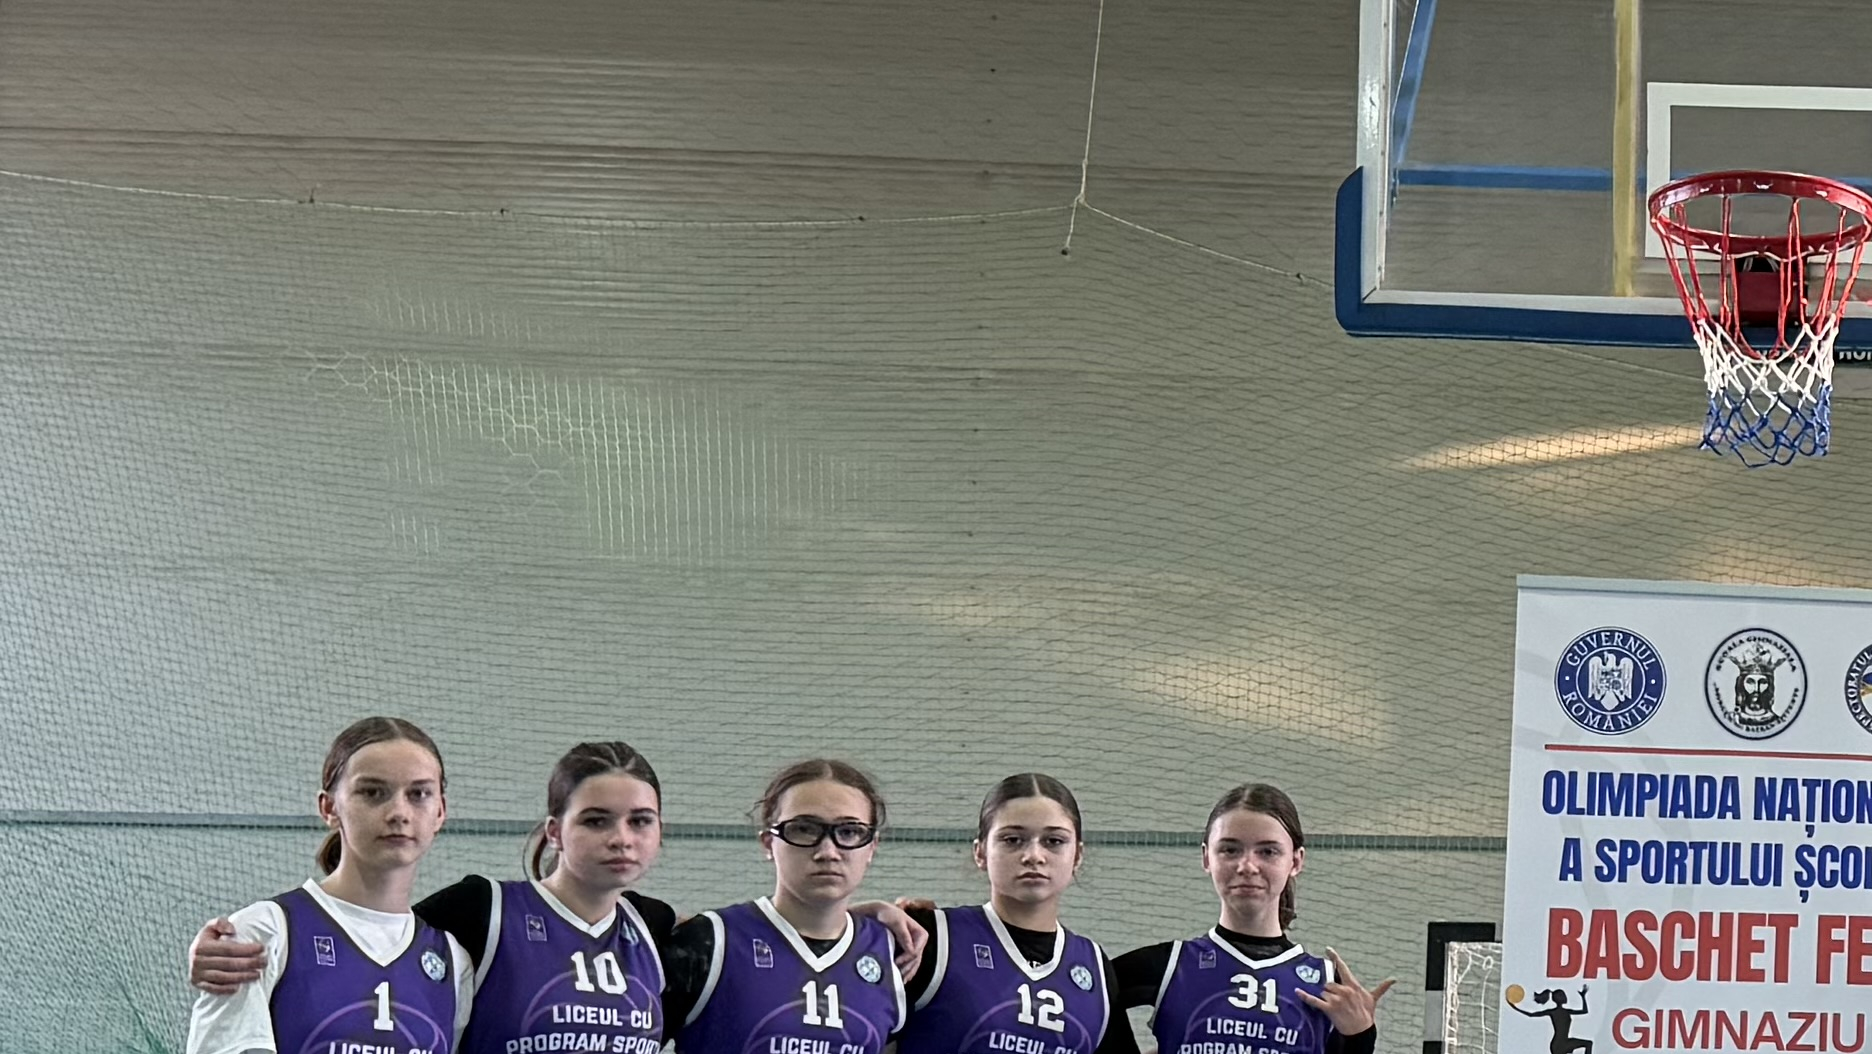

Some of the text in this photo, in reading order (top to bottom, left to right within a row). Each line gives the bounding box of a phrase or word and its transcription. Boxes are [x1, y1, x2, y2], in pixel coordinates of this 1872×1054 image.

[1567, 631, 1656, 670] GUVERNUL
[1542, 769, 1741, 820] OLIMPIADA
[1559, 837, 1583, 882] A
[1595, 838, 1783, 888] SPORTULUI
[1545, 907, 1799, 983] BASCHET
[569, 951, 627, 996] 10
[1227, 973, 1279, 1014] 31
[373, 981, 394, 1031] 1
[552, 1004, 653, 1030] LICEUL CU
[802, 980, 843, 1029] 11
[1017, 983, 1066, 1033] 12
[1206, 1017, 1299, 1046] LICEUL CU
[1611, 1008, 1866, 1054] GIMNAZIU
